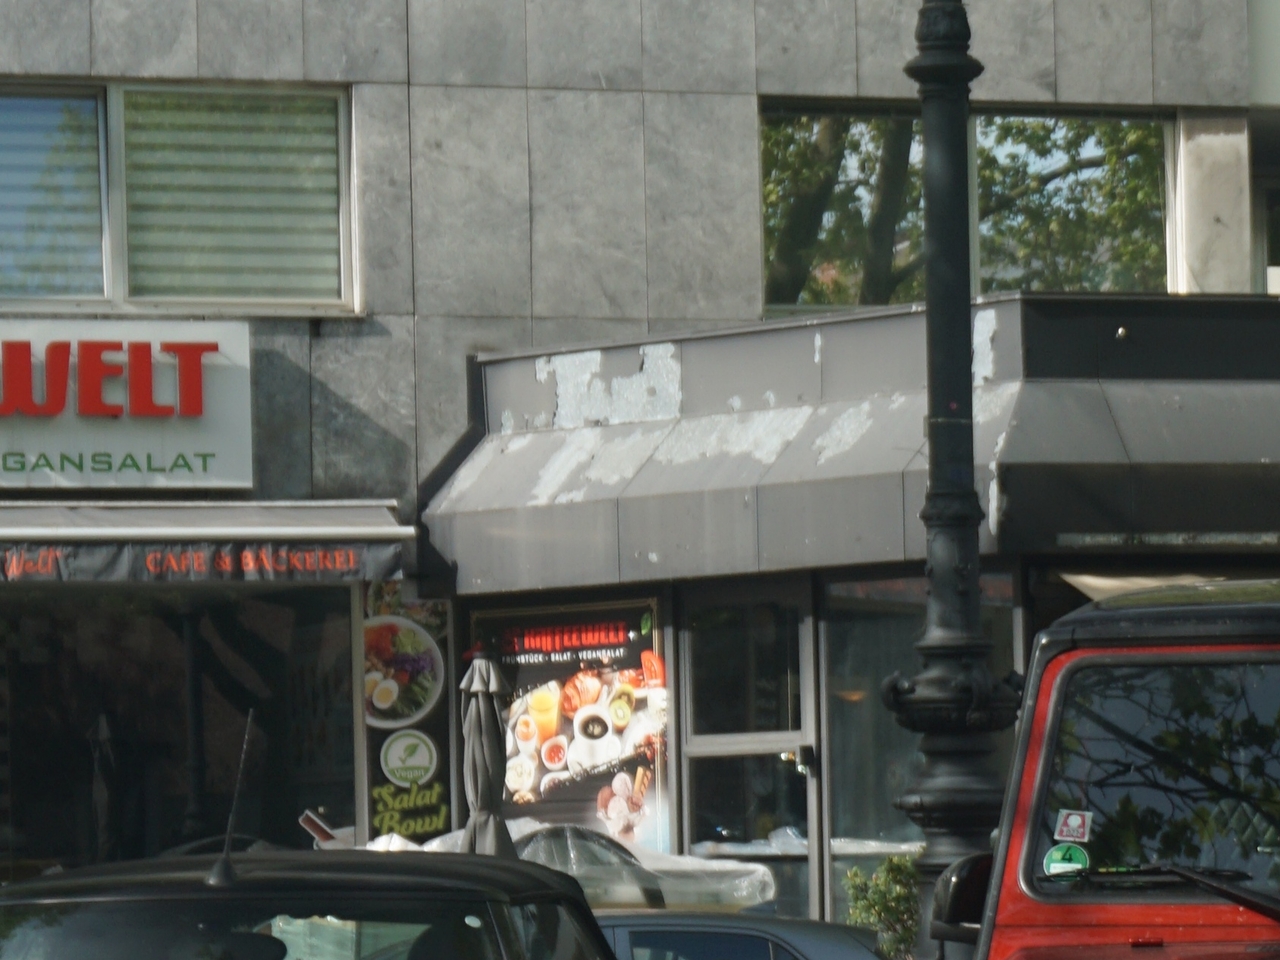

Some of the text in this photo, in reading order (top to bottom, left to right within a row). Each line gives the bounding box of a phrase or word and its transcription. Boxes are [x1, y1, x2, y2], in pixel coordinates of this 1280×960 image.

[213, 550, 232, 572] &
[394, 768, 425, 778] Vegan
[372, 780, 443, 812] Salat
[373, 804, 448, 836] Bowl
[1061, 846, 1073, 863] 4
